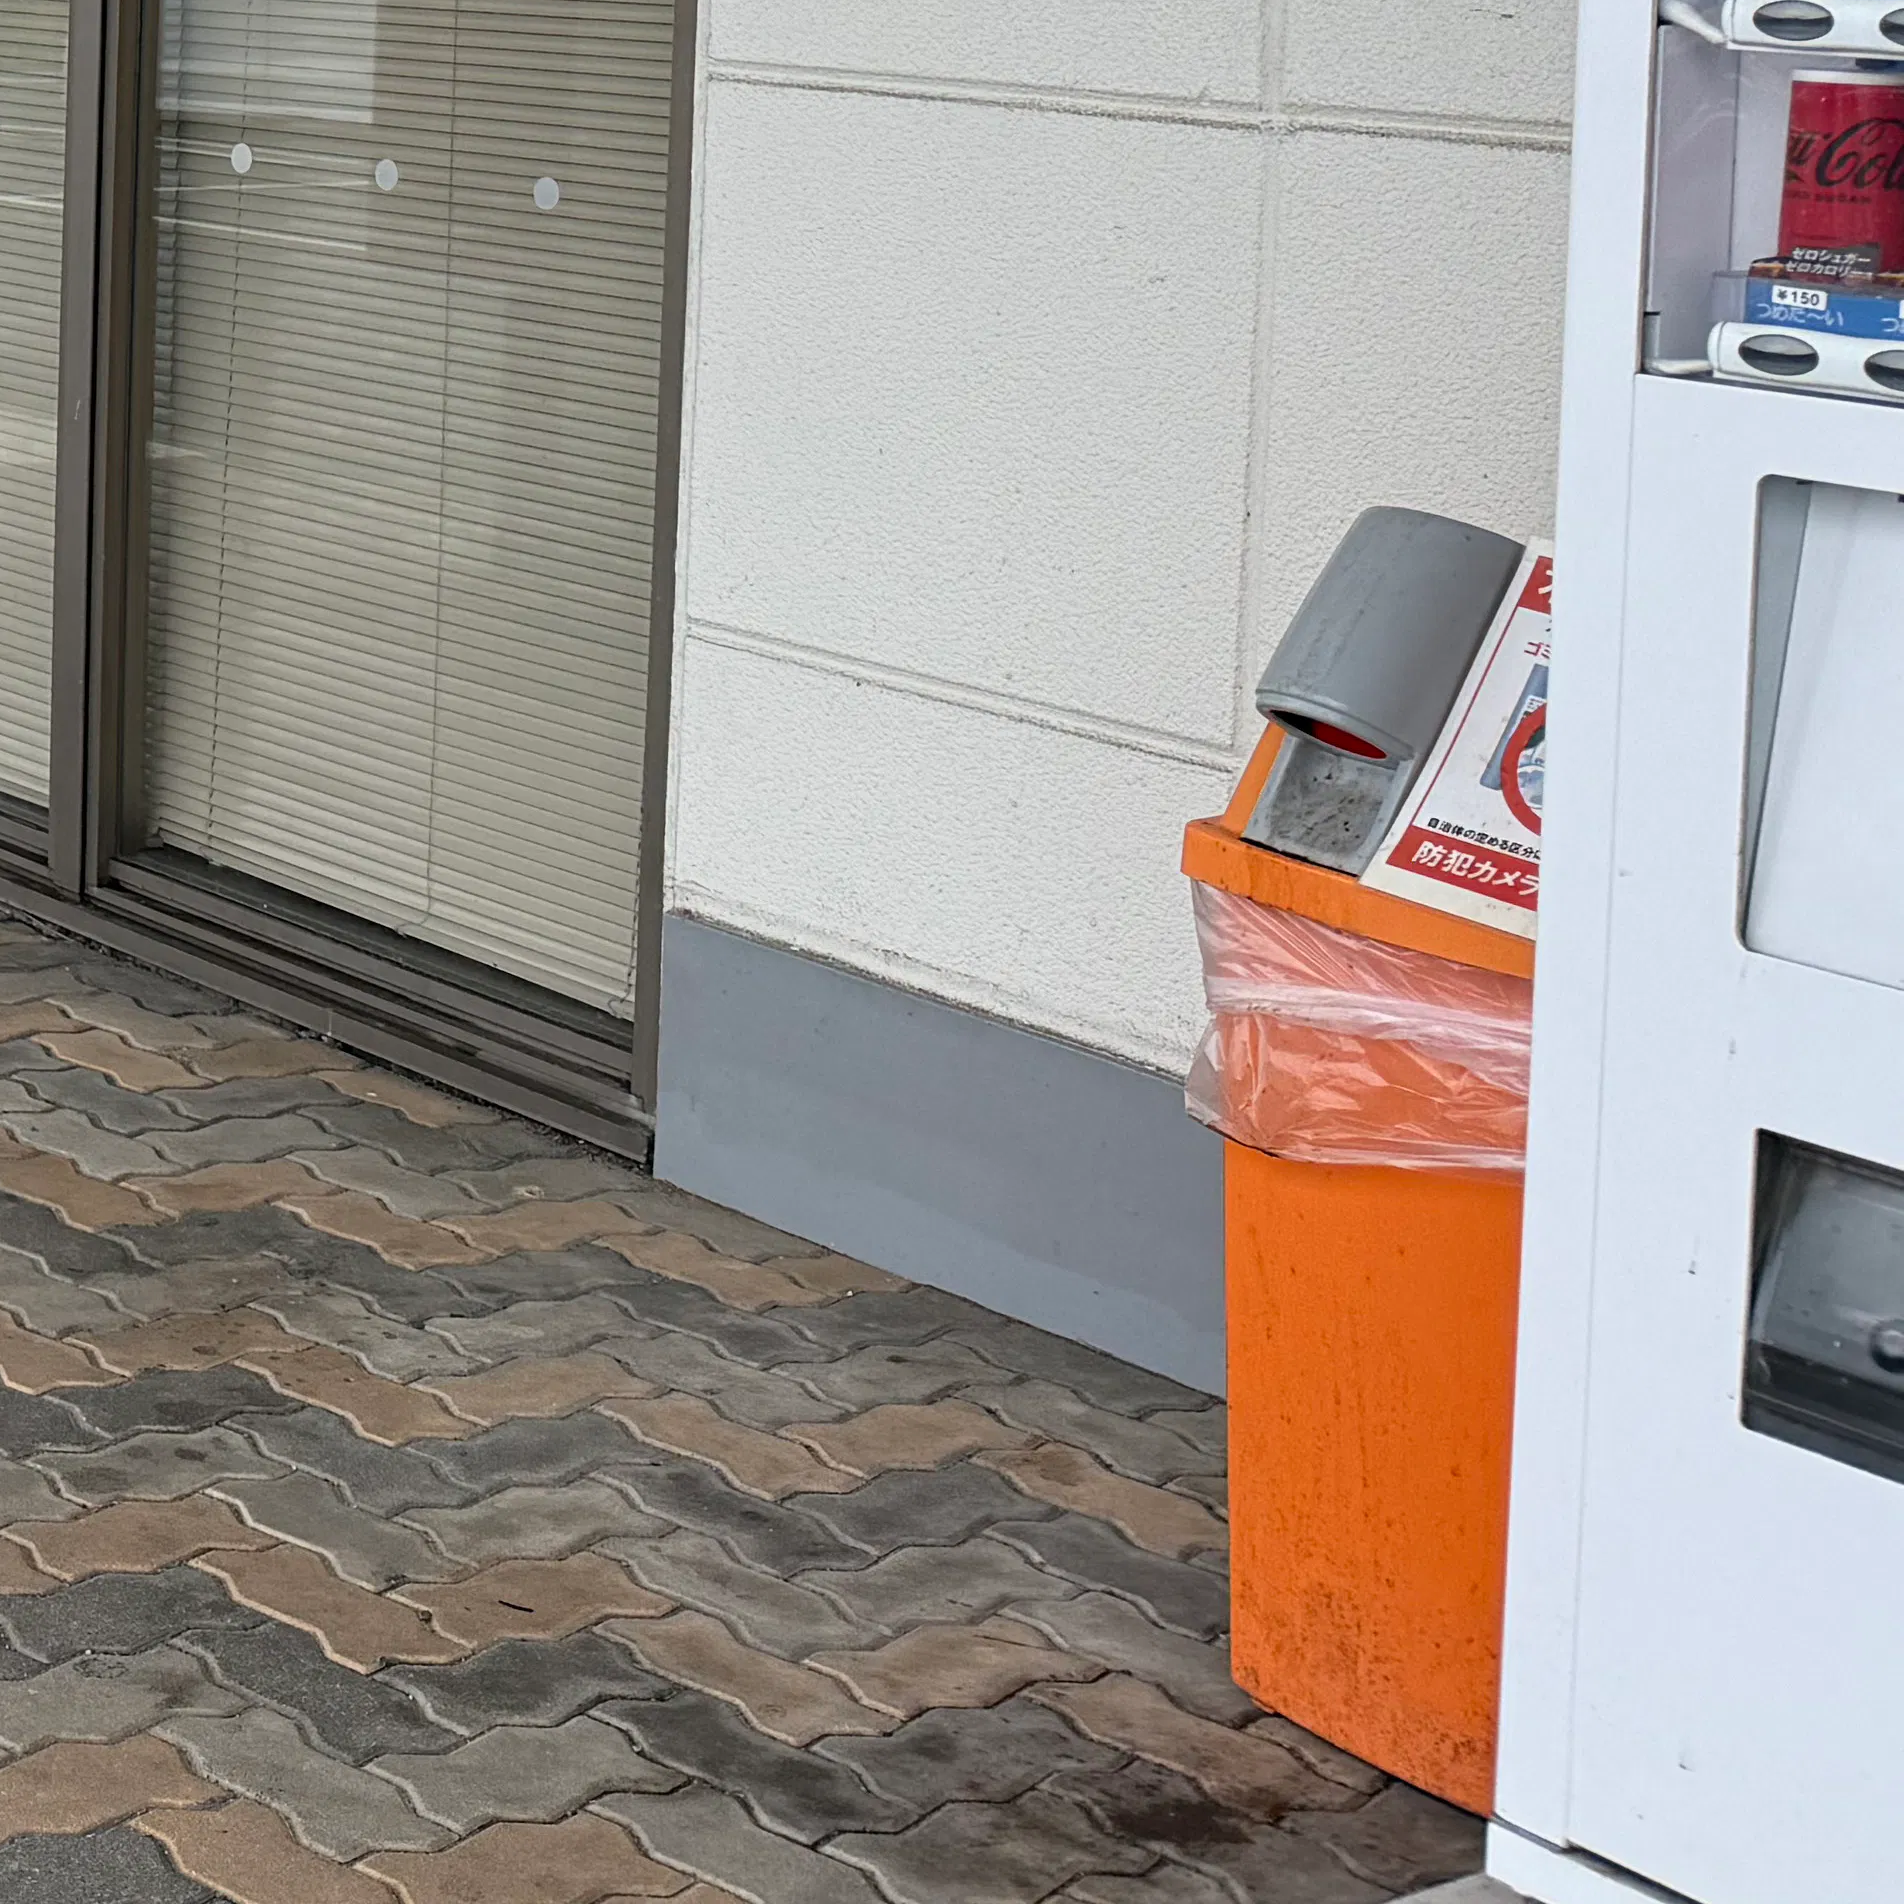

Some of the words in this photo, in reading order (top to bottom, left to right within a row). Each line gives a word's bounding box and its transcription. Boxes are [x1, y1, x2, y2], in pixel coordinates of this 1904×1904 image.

[1792, 247, 1872, 265] ゼロシュガー
[1777, 289, 1820, 307] ¥150
[1411, 840, 1540, 897] 防犯カメラ
